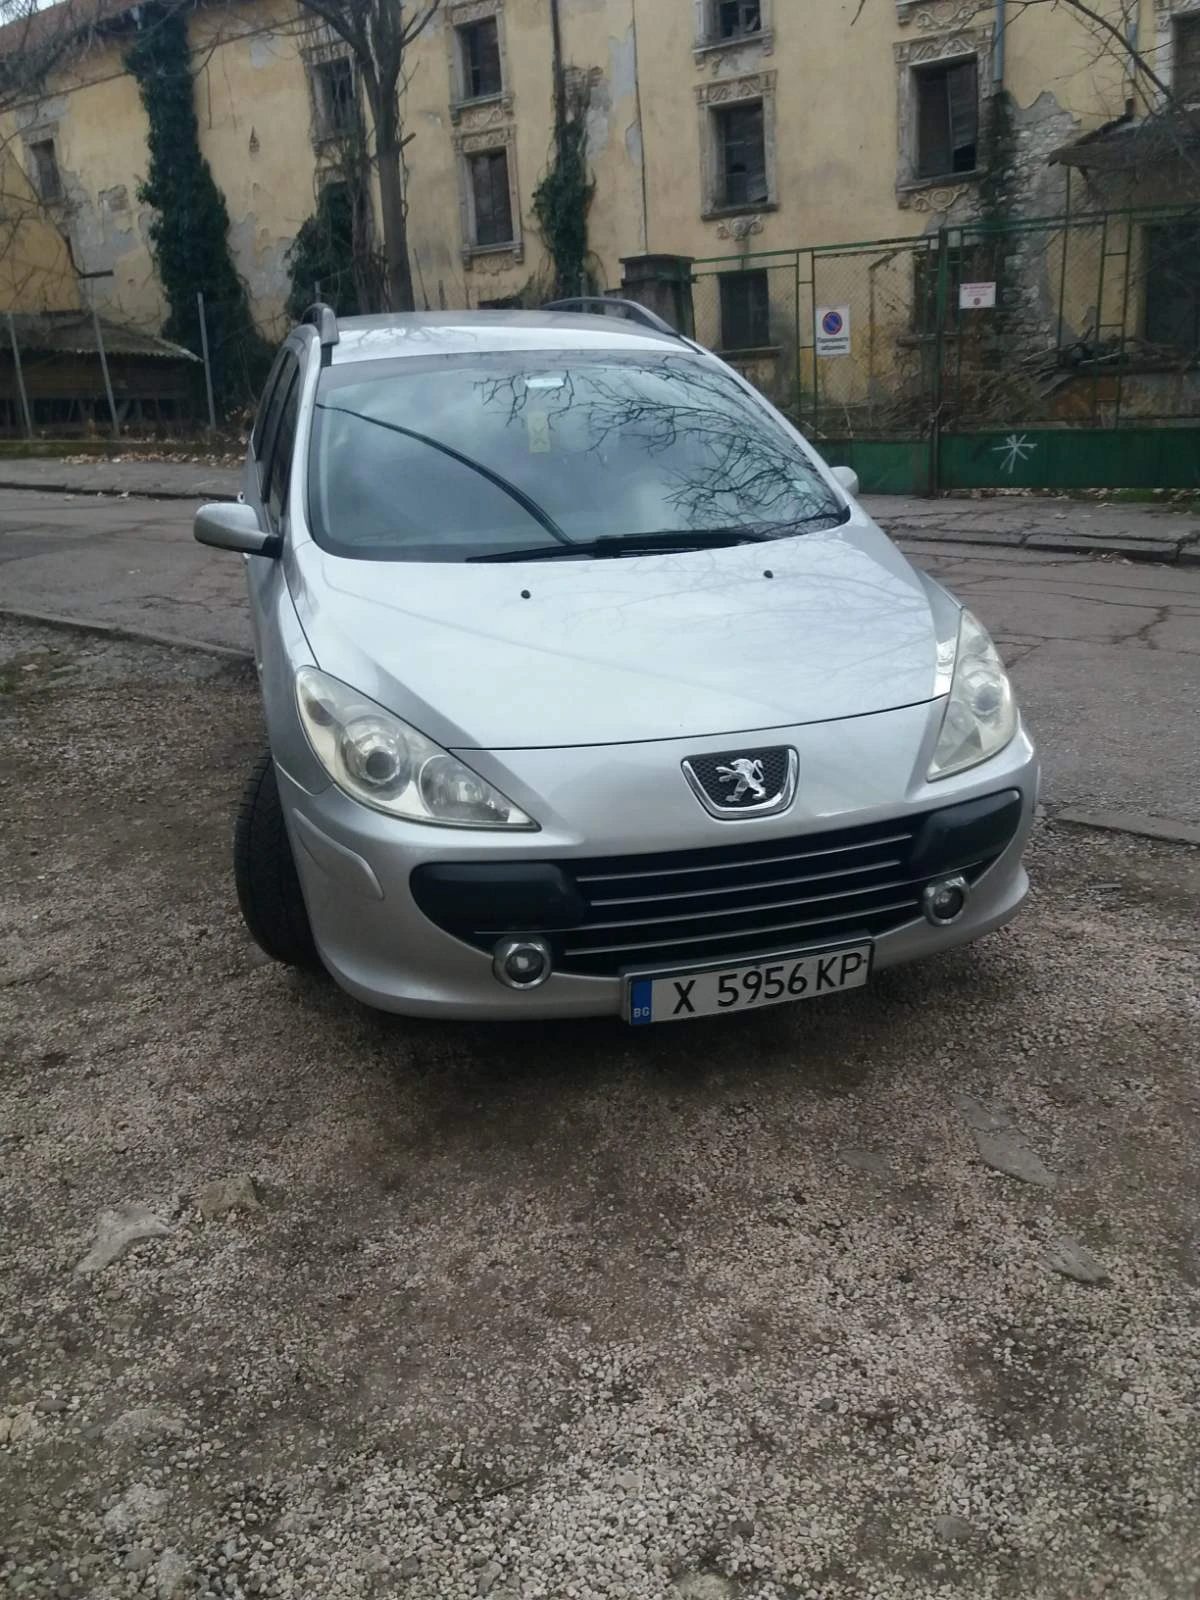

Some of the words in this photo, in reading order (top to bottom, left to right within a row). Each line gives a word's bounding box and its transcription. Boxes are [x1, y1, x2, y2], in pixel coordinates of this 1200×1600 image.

[672, 979, 696, 1014] X
[717, 962, 808, 1007] 5956
[816, 952, 863, 991] KP
[633, 1006, 650, 1018] BG
